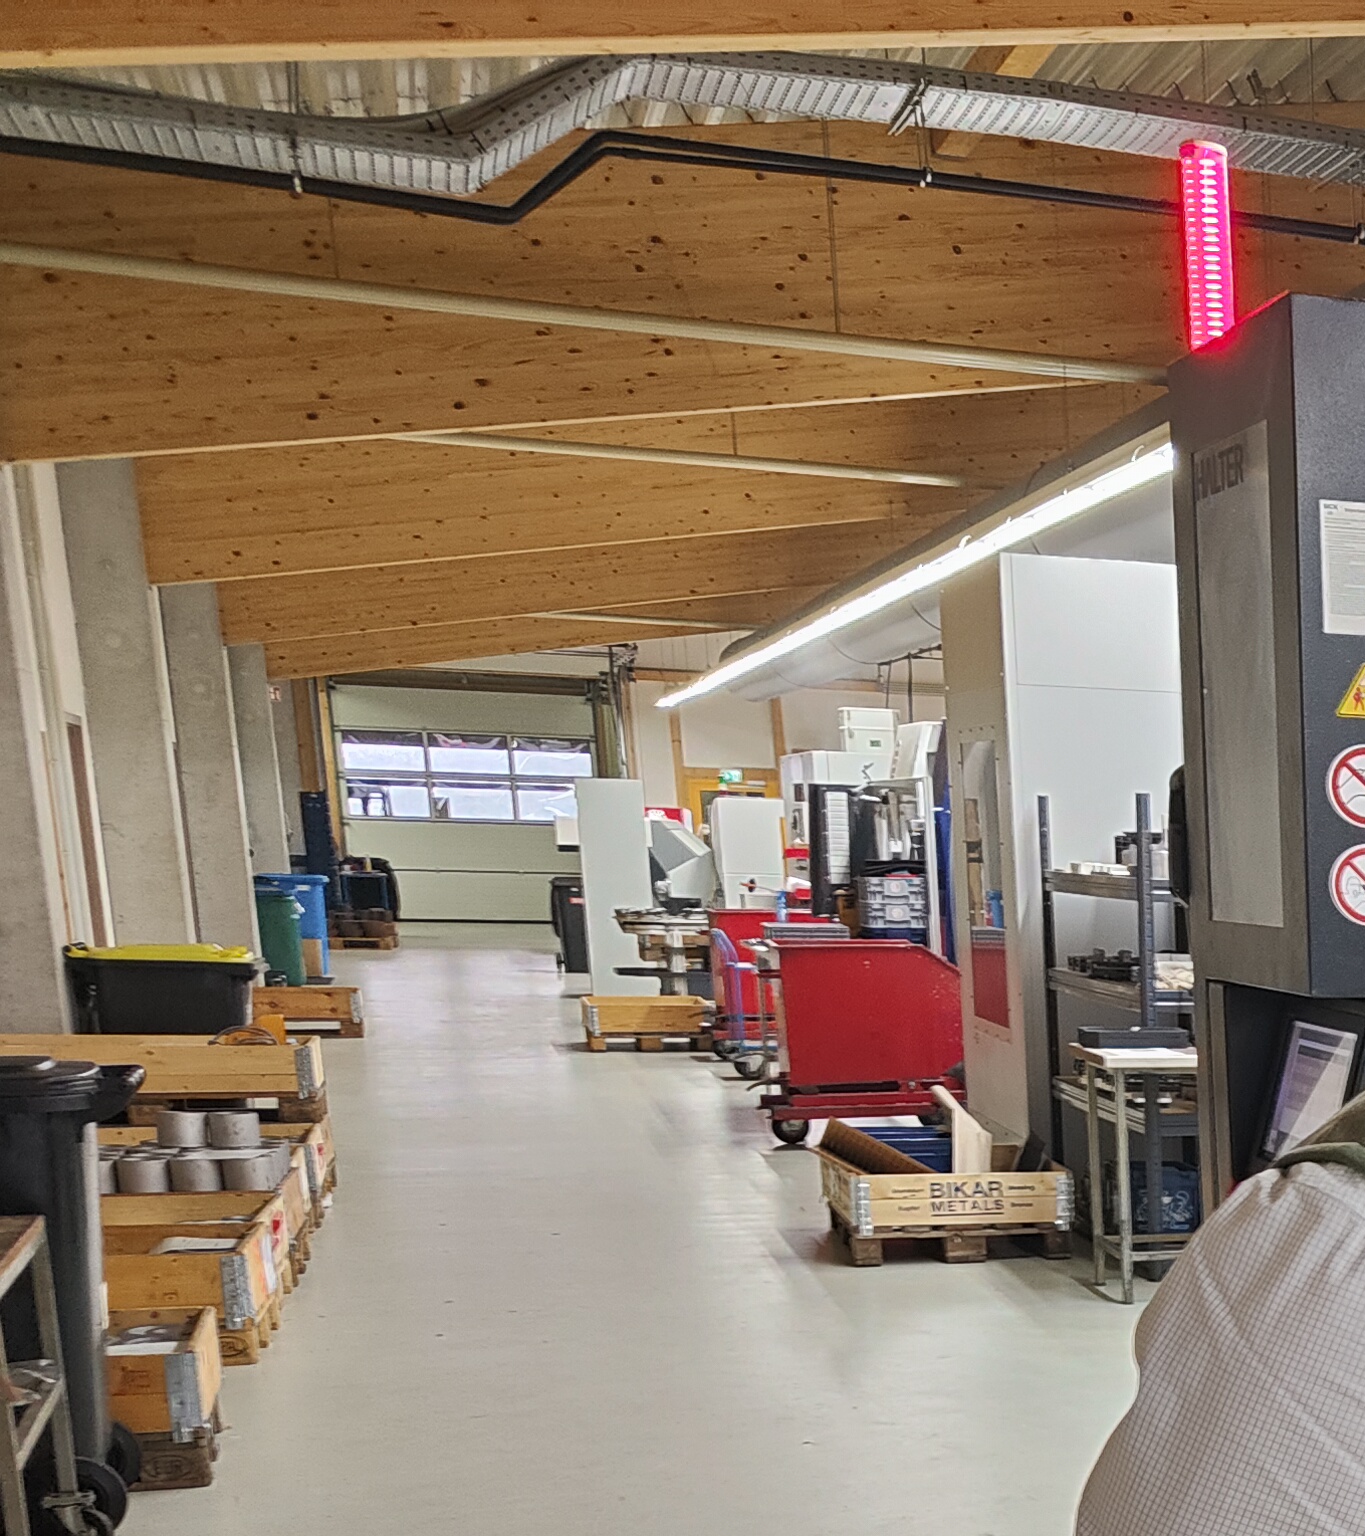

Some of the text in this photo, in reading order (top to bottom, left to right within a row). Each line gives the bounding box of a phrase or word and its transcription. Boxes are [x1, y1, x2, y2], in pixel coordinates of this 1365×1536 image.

[1194, 443, 1244, 501] HALTER
[930, 1181, 1005, 1199] BIKAR
[930, 1199, 1005, 1213] METALS
